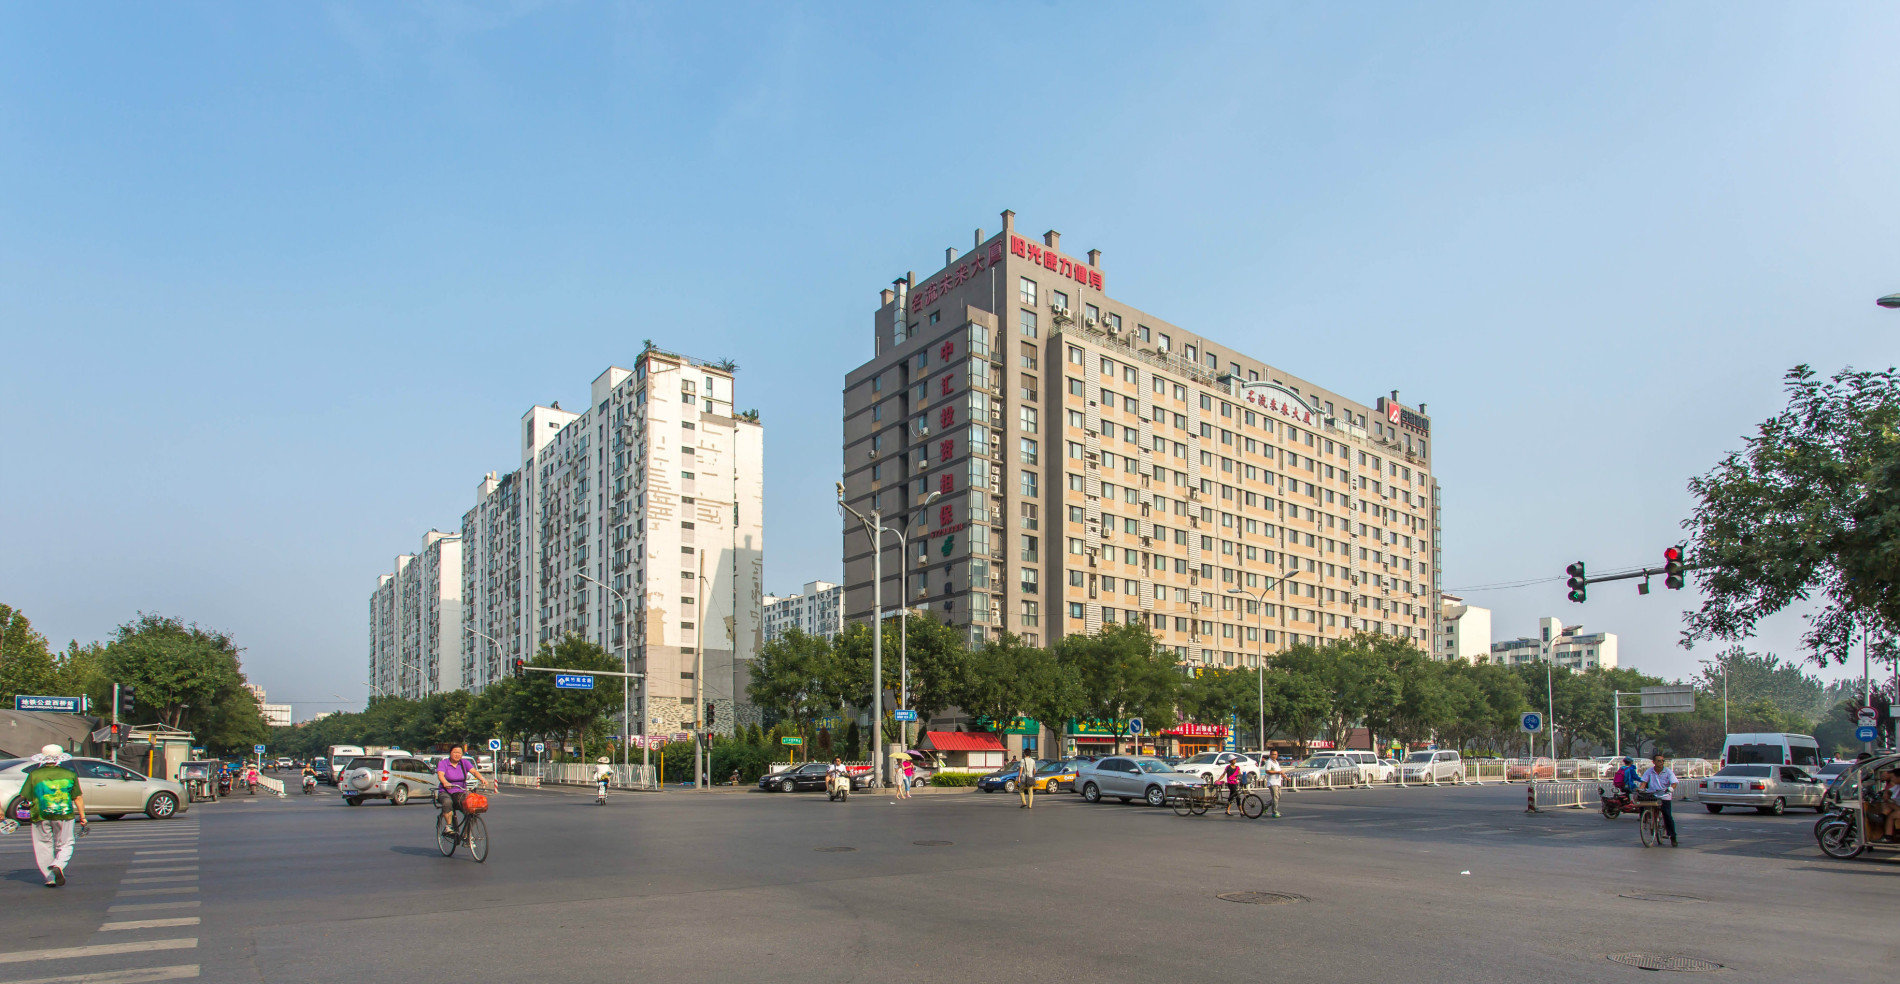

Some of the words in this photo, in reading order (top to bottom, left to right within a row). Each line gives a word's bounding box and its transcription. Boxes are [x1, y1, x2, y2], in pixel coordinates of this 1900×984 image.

[912, 239, 1002, 313] 名流未来大厦
[1011, 235, 1103, 291] 阳光康力健身
[940, 340, 954, 526] 中汇投资担保
